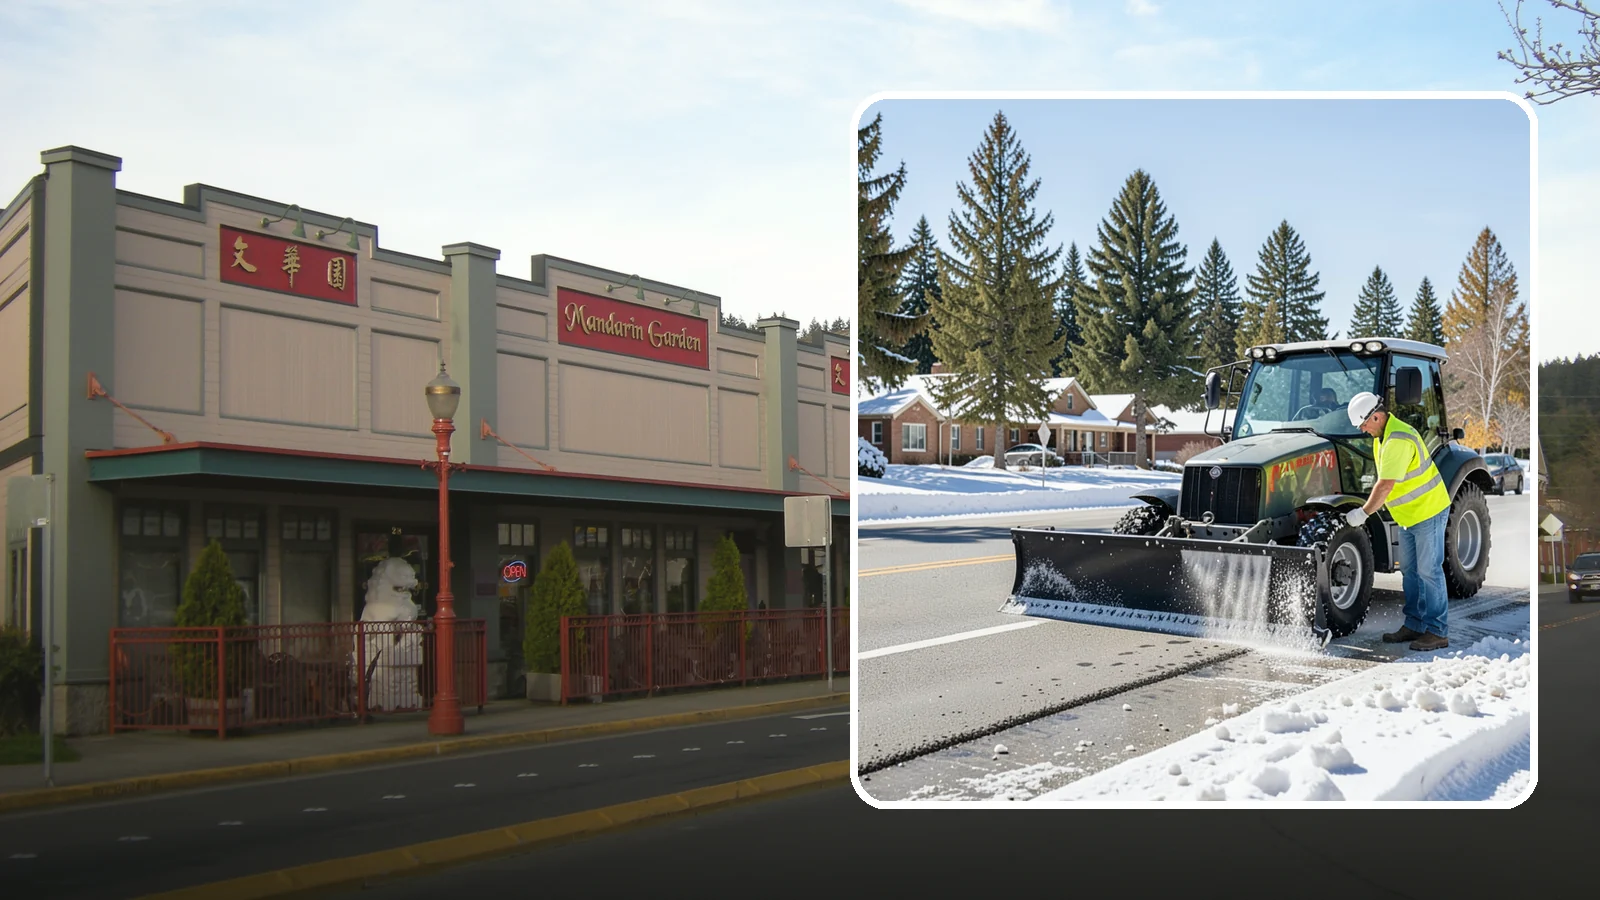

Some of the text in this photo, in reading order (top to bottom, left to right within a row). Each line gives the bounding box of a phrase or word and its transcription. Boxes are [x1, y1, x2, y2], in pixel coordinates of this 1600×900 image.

[564, 302, 701, 352] Mandarin Garden
[503, 565, 526, 578] OPEN
